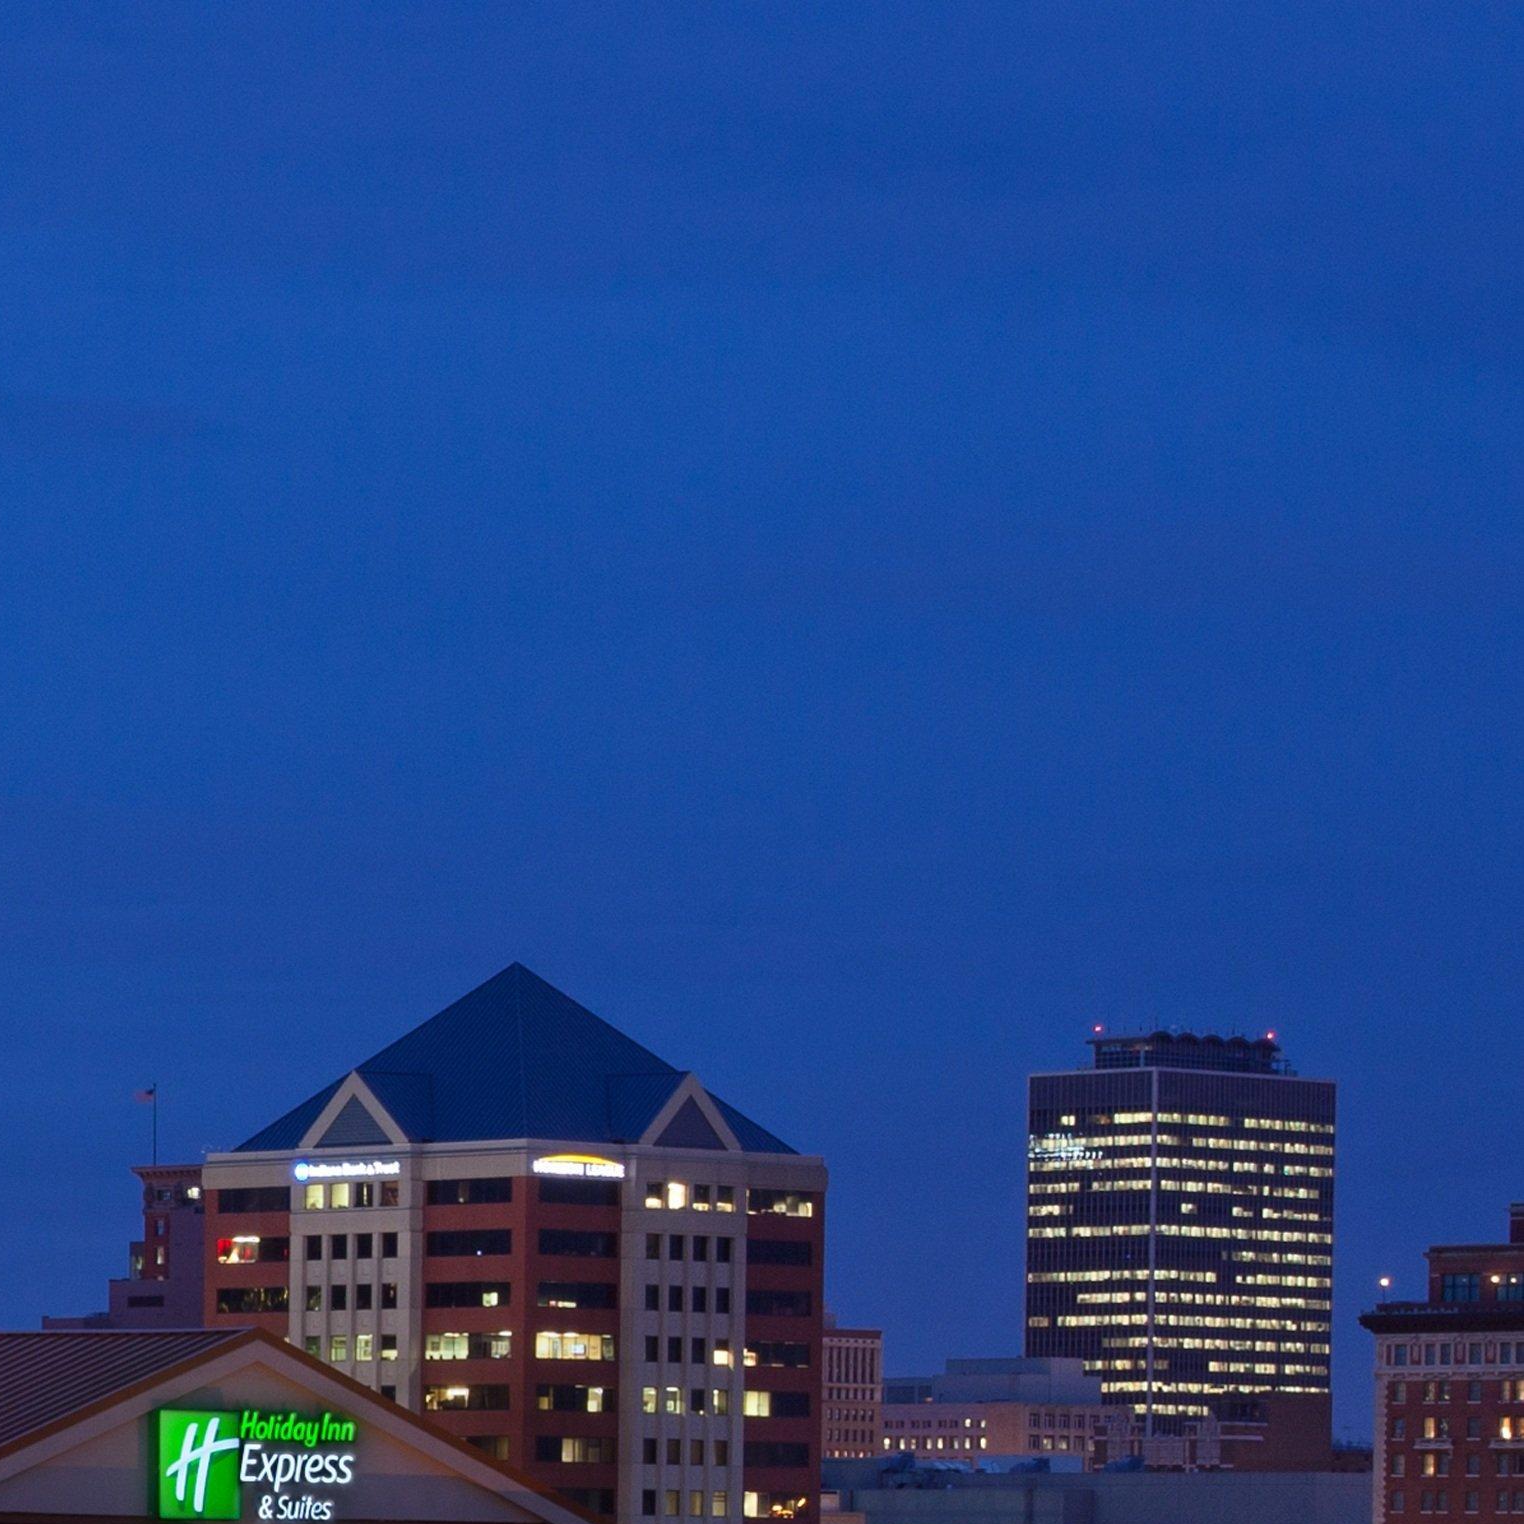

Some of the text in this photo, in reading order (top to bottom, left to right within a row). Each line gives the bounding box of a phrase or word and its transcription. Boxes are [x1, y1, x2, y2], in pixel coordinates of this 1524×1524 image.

[240, 1410, 356, 1447] Holiday Inn
[239, 1443, 355, 1492] Express
[258, 1495, 333, 1520] & Suites
